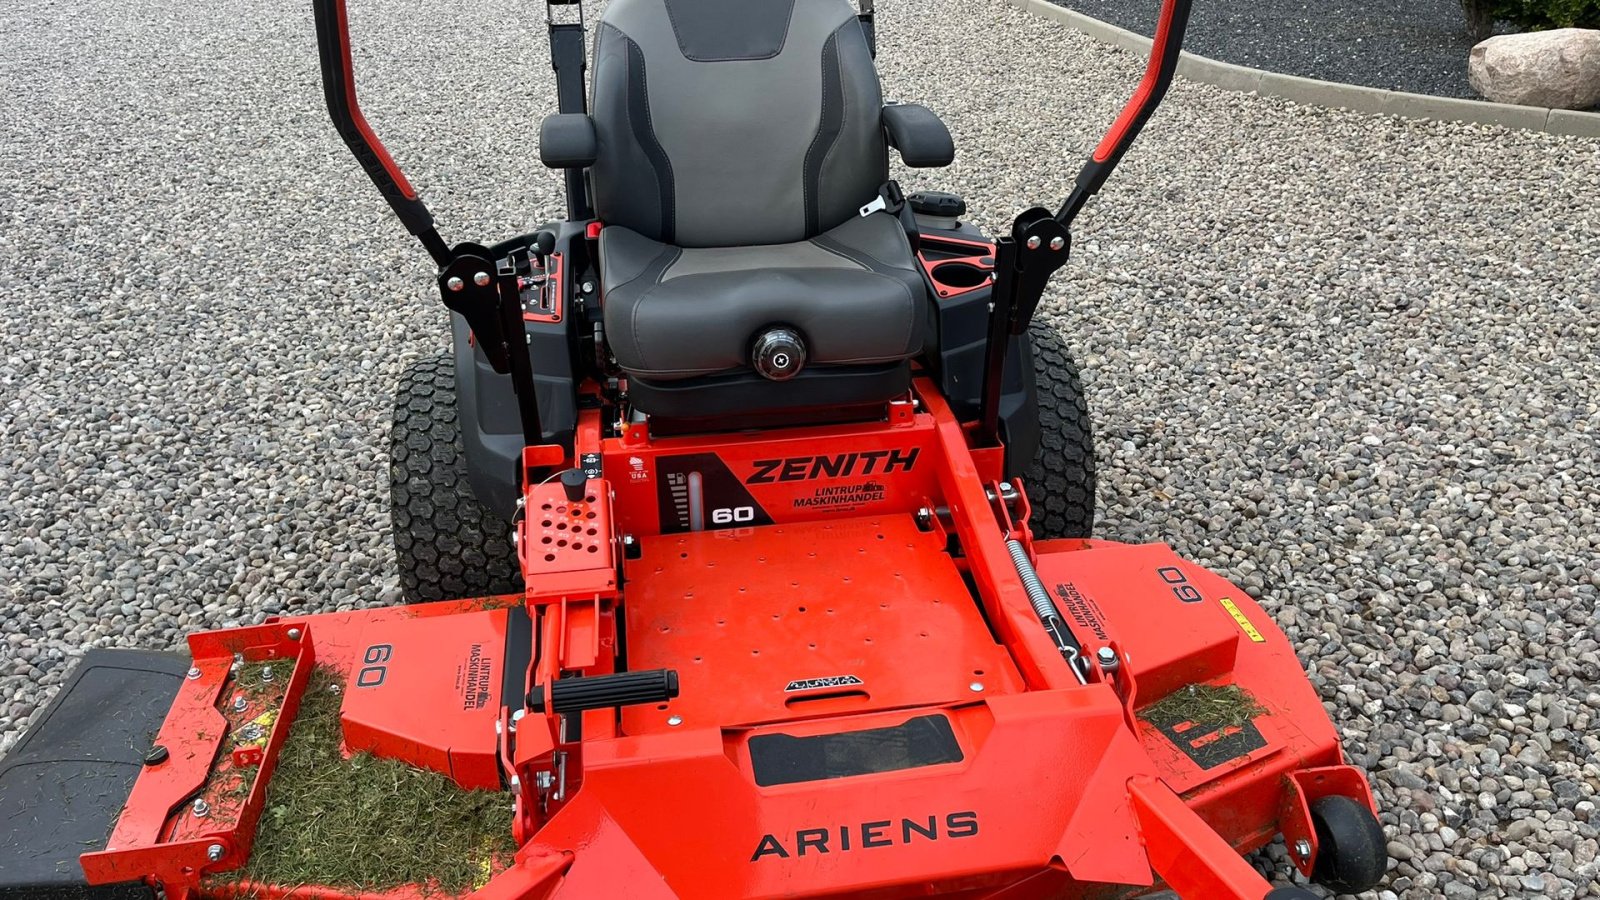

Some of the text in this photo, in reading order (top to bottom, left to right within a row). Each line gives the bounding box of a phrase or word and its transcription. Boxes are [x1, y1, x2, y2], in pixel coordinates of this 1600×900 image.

[746, 448, 921, 485] ZENITH
[793, 492, 885, 507] MASKINHANDEL
[815, 485, 862, 497] LINTRUP
[712, 506, 754, 523] 60
[1157, 567, 1203, 603] 60
[1062, 594, 1089, 627] LINTRUP
[1064, 582, 1109, 640] MASKINHANDEL
[356, 643, 393, 688] 60
[463, 643, 482, 711] MASKINHANDEL
[478, 657, 491, 692] LINTRUP
[750, 811, 978, 862] ARIENS
